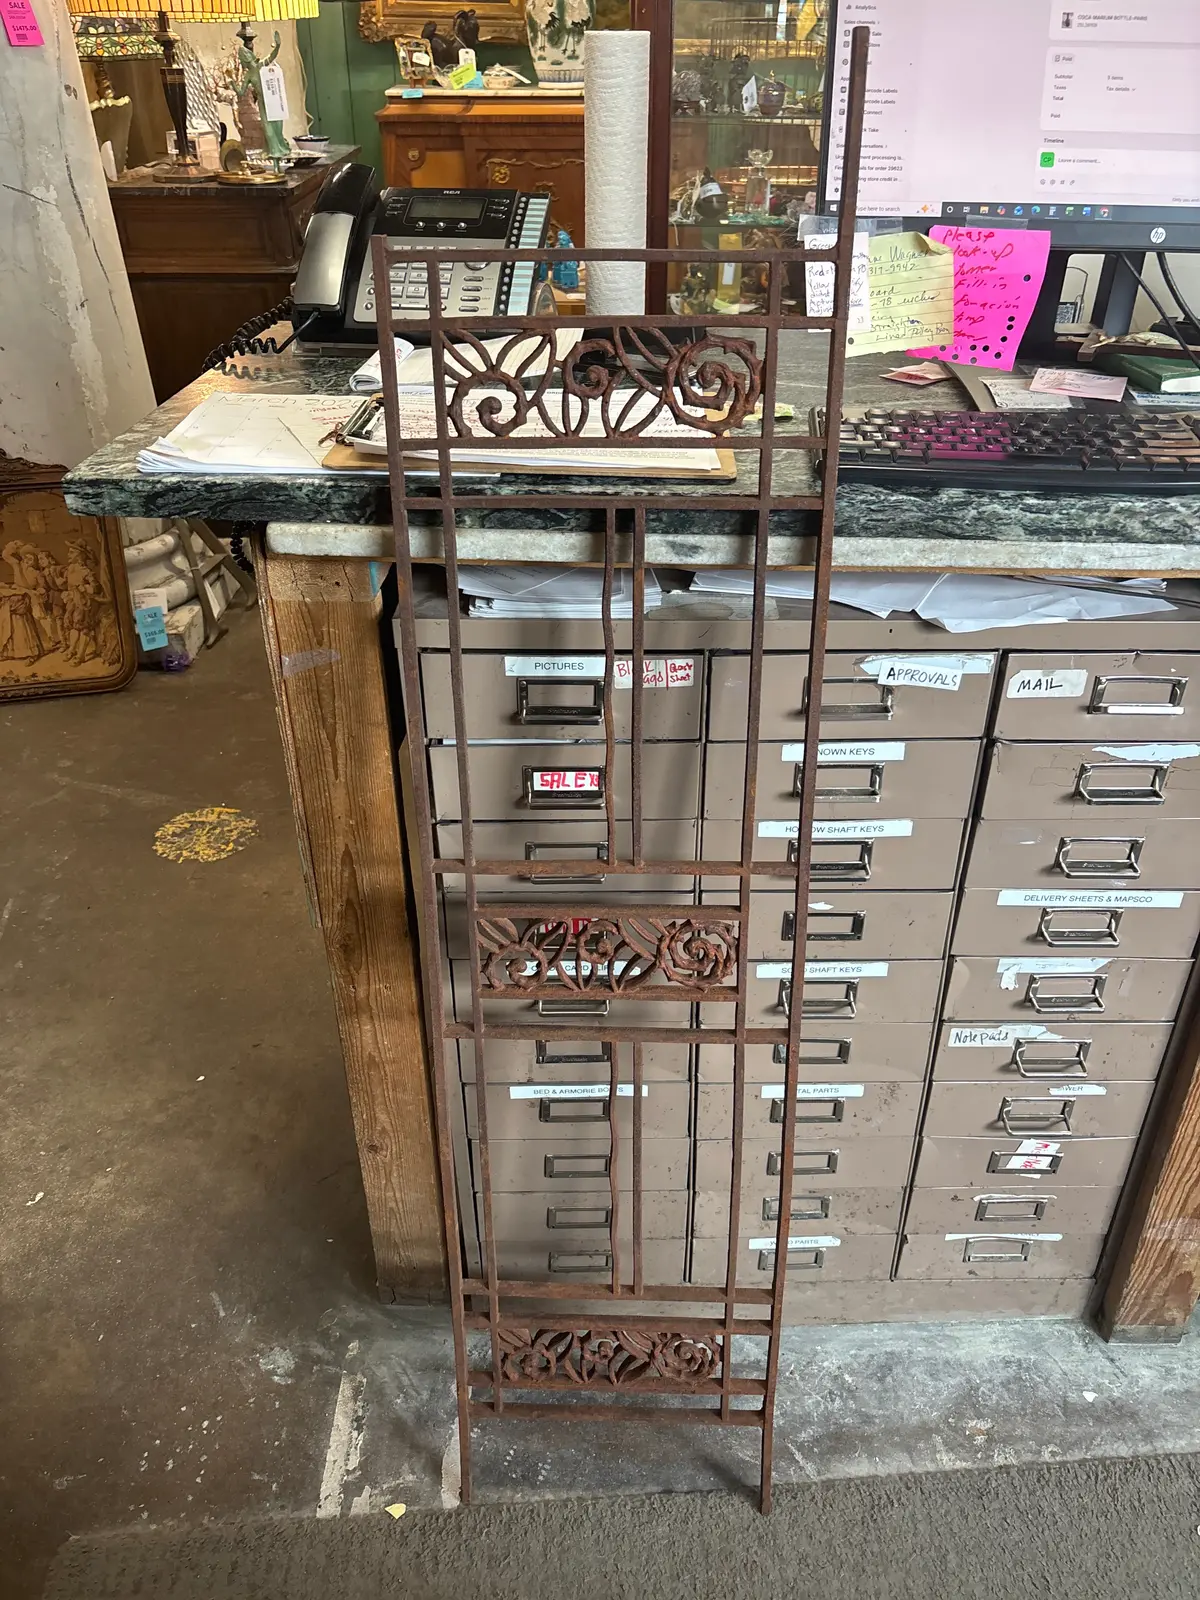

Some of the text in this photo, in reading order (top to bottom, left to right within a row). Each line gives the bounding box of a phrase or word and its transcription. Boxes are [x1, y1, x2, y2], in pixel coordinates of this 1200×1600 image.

[1150, 227, 1166, 244] hp
[534, 662, 584, 671] PICTURES
[886, 667, 957, 686] APPROVALS
[1017, 677, 1063, 693] MAIL
[817, 748, 875, 756] NOWN KEYS
[540, 771, 588, 789] SALE
[827, 826, 858, 834] SHAFT
[1024, 894, 1068, 902] DELIVERY
[1068, 895, 1104, 903] SHEETS
[560, 1087, 596, 1095] ARMORIE
[597, 1086, 624, 1094] BOS
